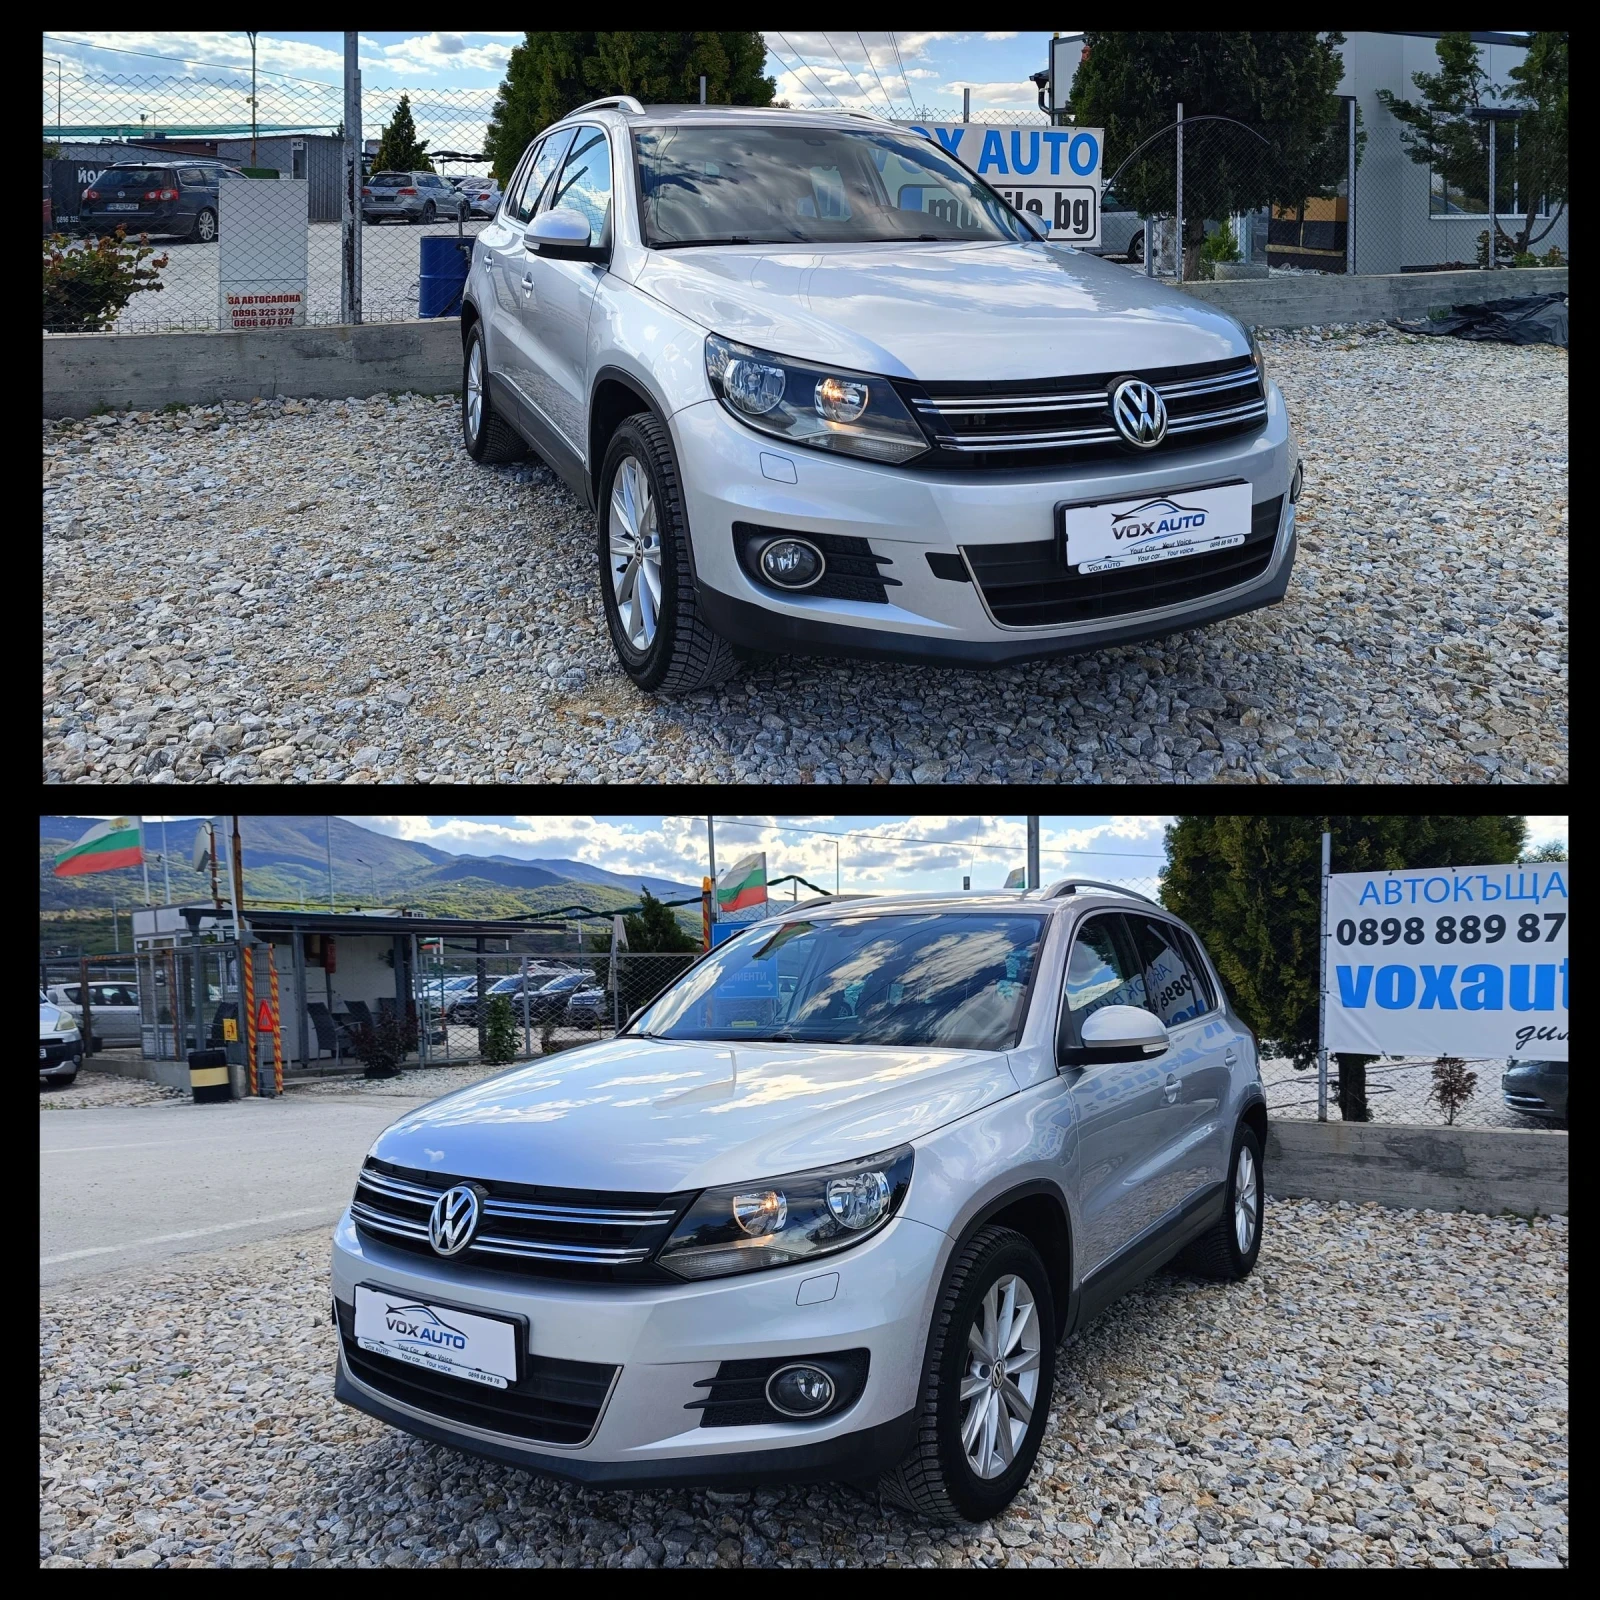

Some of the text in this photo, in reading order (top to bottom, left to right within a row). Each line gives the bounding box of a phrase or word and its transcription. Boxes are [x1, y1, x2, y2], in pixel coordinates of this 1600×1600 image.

[977, 129, 1099, 176] AUTO
[228, 294, 301, 305] ЗА АВТОСАЛОНА
[232, 307, 295, 317] 0896 325 324
[234, 319, 258, 328] 0896
[259, 318, 276, 327] 847
[1111, 513, 1206, 540] VOX AUTO
[1129, 547, 1144, 555] Your
[1162, 541, 1177, 549] Your
[1137, 554, 1150, 562] Your
[1166, 549, 1179, 558] Your
[1358, 871, 1568, 906] АВТОКЪЩА
[1336, 912, 1567, 946] 0898 889 87
[730, 971, 767, 982] ЛИЕНТИ
[385, 1316, 466, 1350] VOX AUTO
[397, 1342, 409, 1352] Your
[401, 1352, 412, 1361] Your
[426, 1359, 437, 1368] Your
